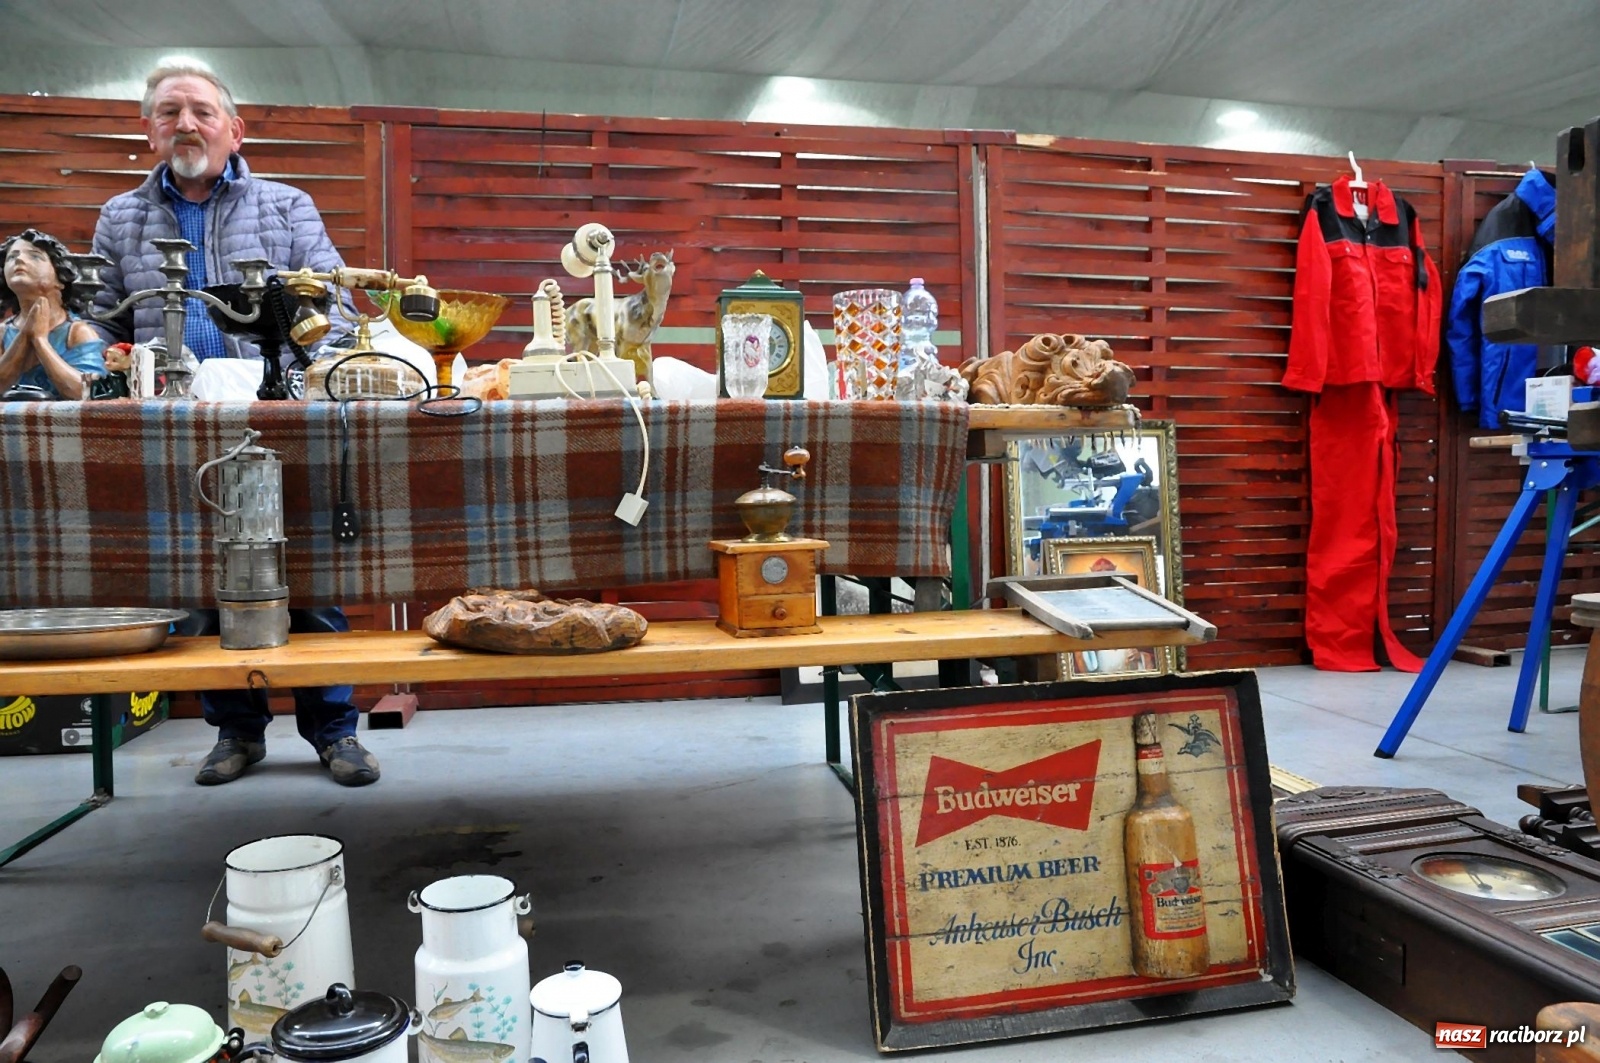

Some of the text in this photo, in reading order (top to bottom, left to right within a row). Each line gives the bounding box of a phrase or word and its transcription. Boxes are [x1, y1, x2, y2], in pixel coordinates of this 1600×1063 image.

[934, 780, 1082, 814] Budweiser
[919, 856, 1100, 891] PREMIUM BEER
[1013, 938, 1065, 975] Inc.
